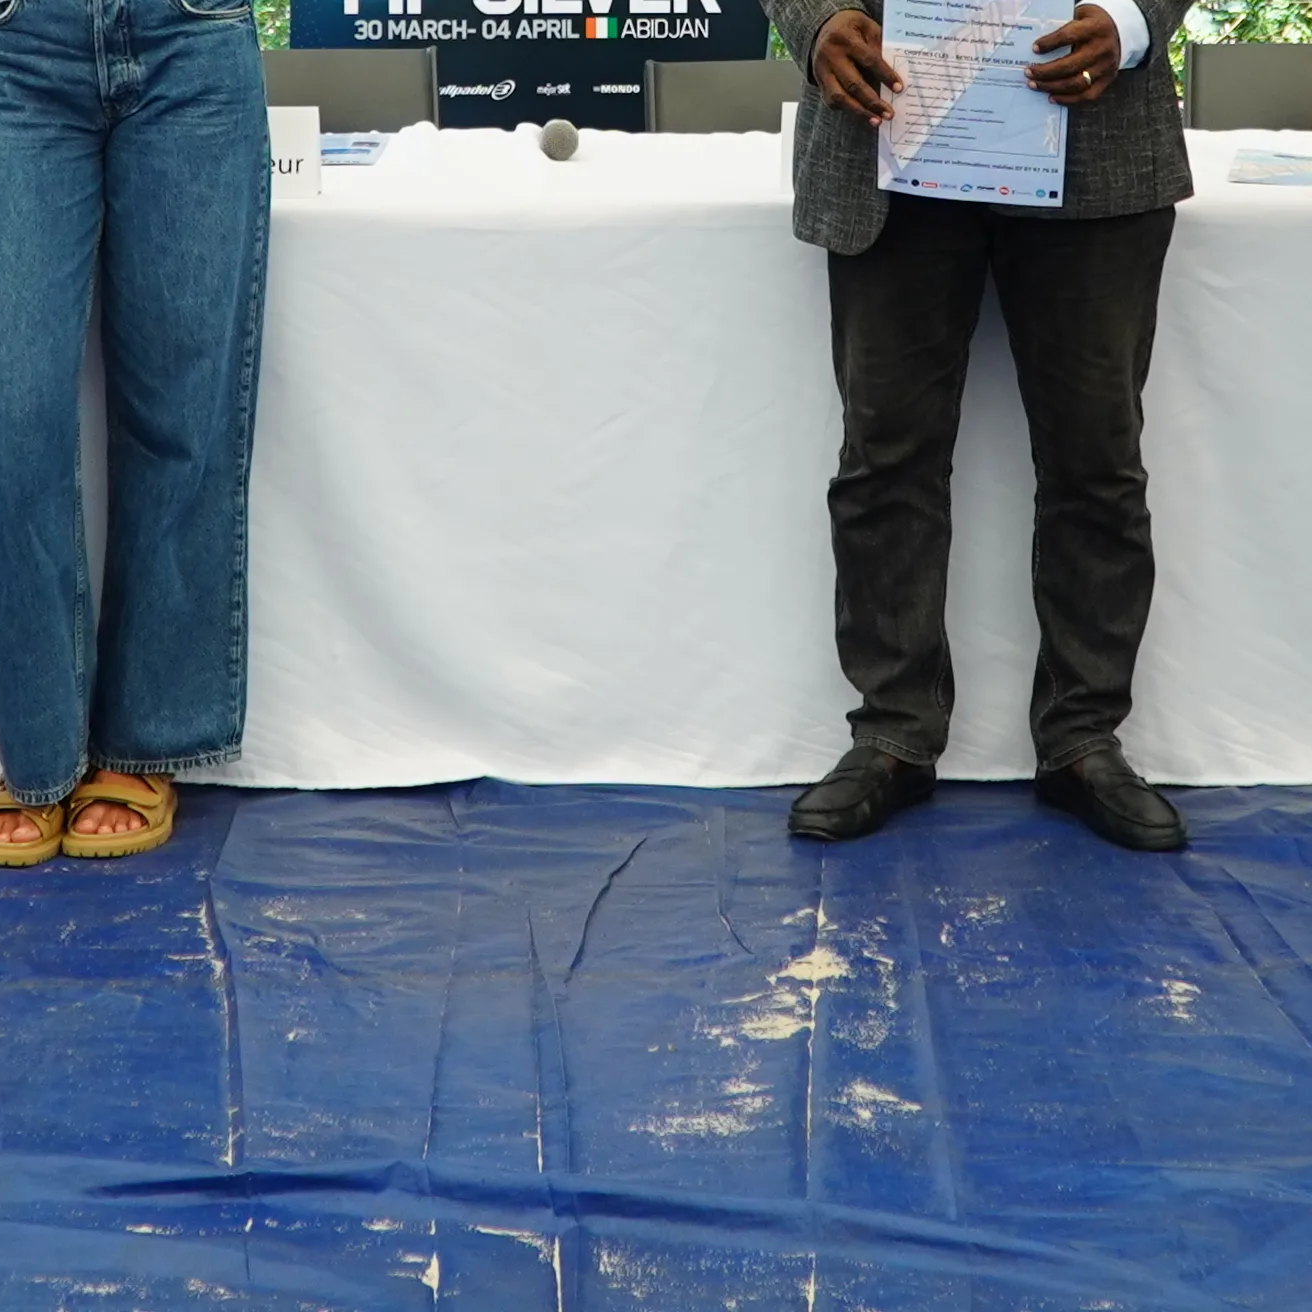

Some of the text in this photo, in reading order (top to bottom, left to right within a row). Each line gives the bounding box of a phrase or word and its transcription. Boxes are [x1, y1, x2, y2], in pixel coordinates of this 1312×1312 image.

[354, 18, 709, 40] 30 MARCH- 04 APRIL ABIDJAN
